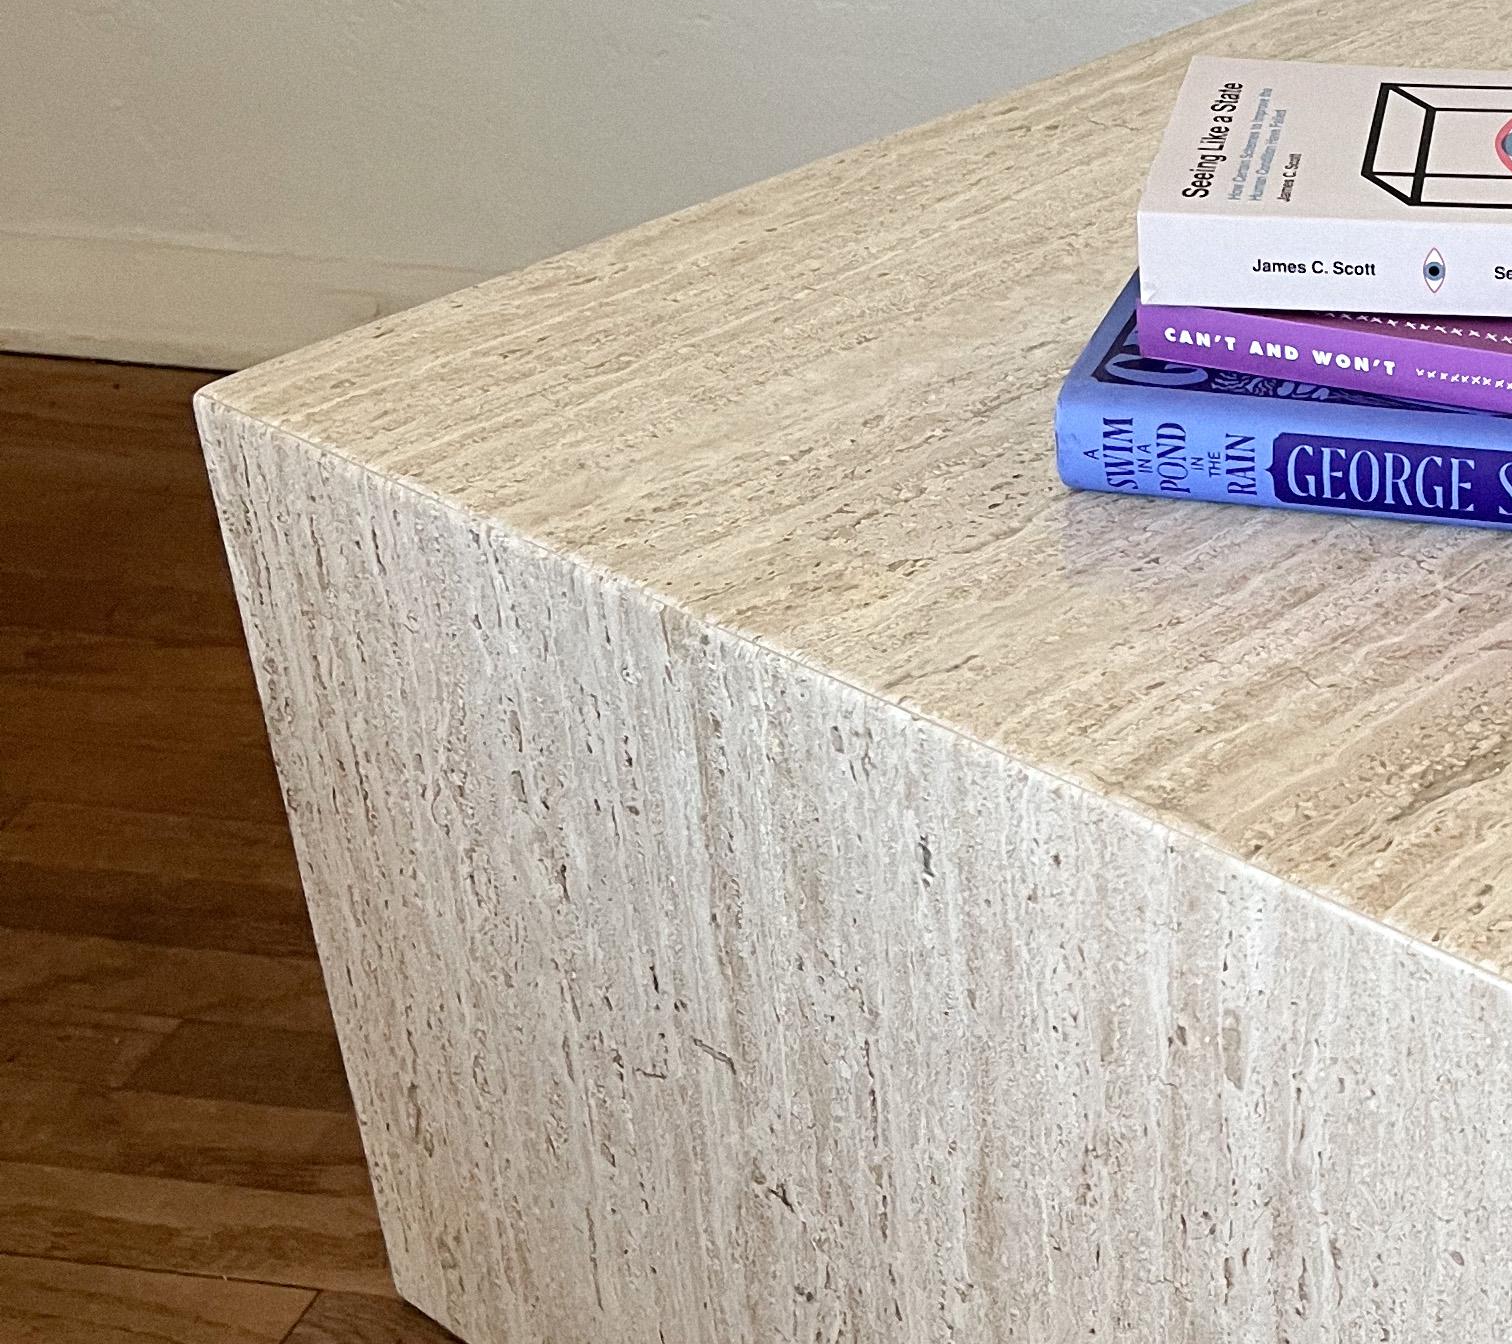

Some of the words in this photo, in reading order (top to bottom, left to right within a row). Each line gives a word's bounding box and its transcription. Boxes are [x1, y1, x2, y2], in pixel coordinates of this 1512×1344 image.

[1210, 82, 1243, 113] State
[1213, 115, 1233, 123] a
[1197, 126, 1230, 151] Like
[1285, 153, 1302, 169] Scott
[1181, 154, 1227, 198] Seeing
[1277, 179, 1295, 202] James
[1252, 259, 1307, 273] James
[1312, 260, 1329, 274] C.
[1333, 261, 1376, 276] Scott
[1164, 327, 1237, 352] CAN'T
[1249, 340, 1299, 361] AND
[1312, 349, 1396, 376] WON'T
[1083, 448, 1100, 460] A
[1102, 417, 1139, 490] SWIM
[1136, 444, 1152, 454] A
[1156, 422, 1191, 494] POND
[1138, 458, 1153, 474] IN
[1191, 456, 1204, 471] IN
[1208, 451, 1221, 478] THE
[1225, 433, 1257, 496] RAIN
[1286, 444, 1475, 512] GEORGE
